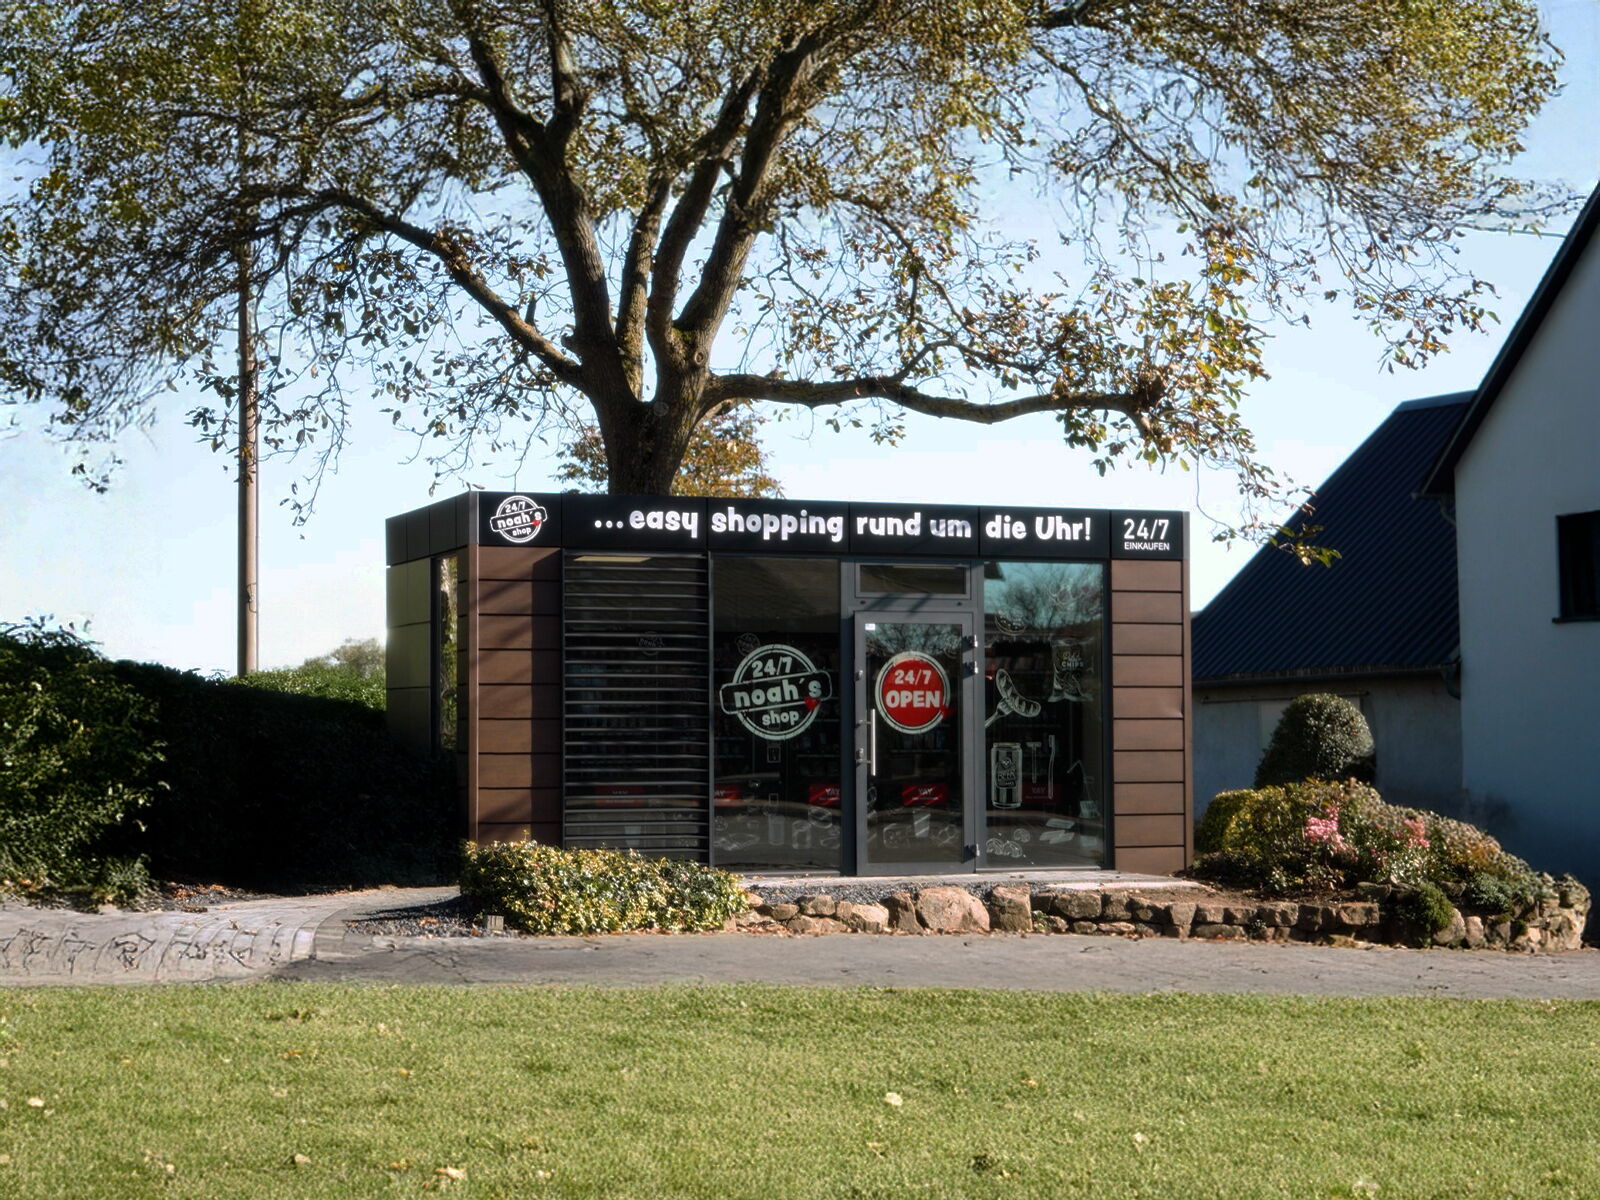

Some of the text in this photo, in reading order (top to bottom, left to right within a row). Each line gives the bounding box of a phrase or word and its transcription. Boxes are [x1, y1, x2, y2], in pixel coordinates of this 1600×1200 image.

[505, 501, 526, 513] 24/7
[512, 527, 532, 536] shop
[710, 507, 844, 543] shopping
[856, 511, 922, 537] rund
[929, 518, 972, 539] um
[984, 513, 1028, 540] die
[1034, 515, 1092, 541] Uhr!
[1123, 518, 1170, 541] 24/7
[1123, 541, 1171, 551] EINKAUFEN
[751, 656, 793, 679] 24/7
[894, 669, 932, 686] 24/7
[885, 690, 940, 708] OPEN
[761, 710, 800, 726] shop
